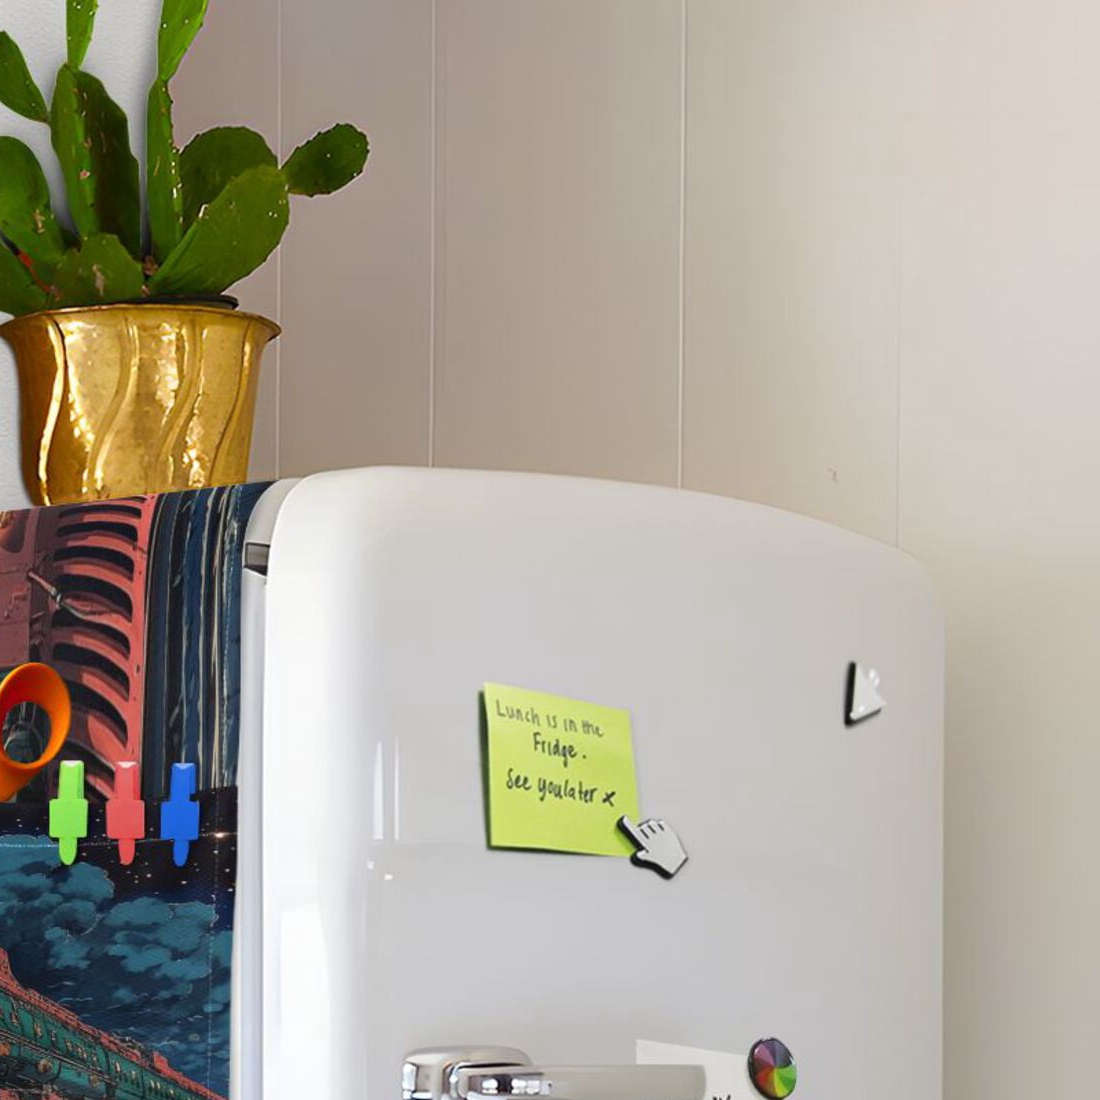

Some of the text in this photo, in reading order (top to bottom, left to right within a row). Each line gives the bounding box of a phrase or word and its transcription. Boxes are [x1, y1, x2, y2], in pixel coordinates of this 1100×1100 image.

[496, 699, 604, 738] Lunch is in the
[506, 767, 532, 791] See
